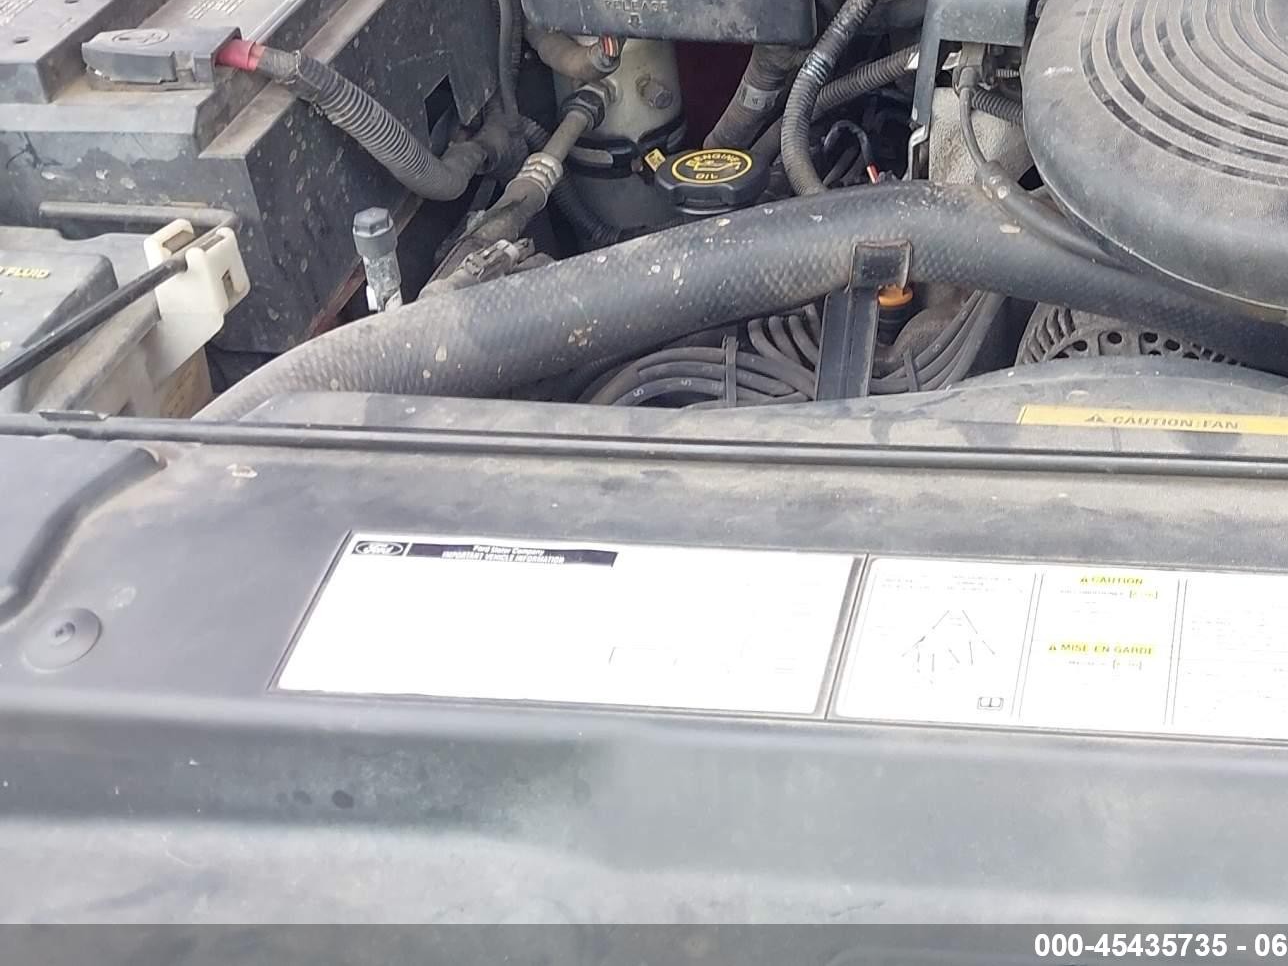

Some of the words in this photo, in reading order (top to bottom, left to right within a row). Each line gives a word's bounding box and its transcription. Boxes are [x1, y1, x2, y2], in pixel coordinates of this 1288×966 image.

[7, 266, 50, 280] FLUID
[1203, 420, 1239, 430] FAN
[1091, 577, 1143, 585] CAUTION
[1060, 644, 1086, 652] MISE
[1114, 646, 1152, 654] GARDE
